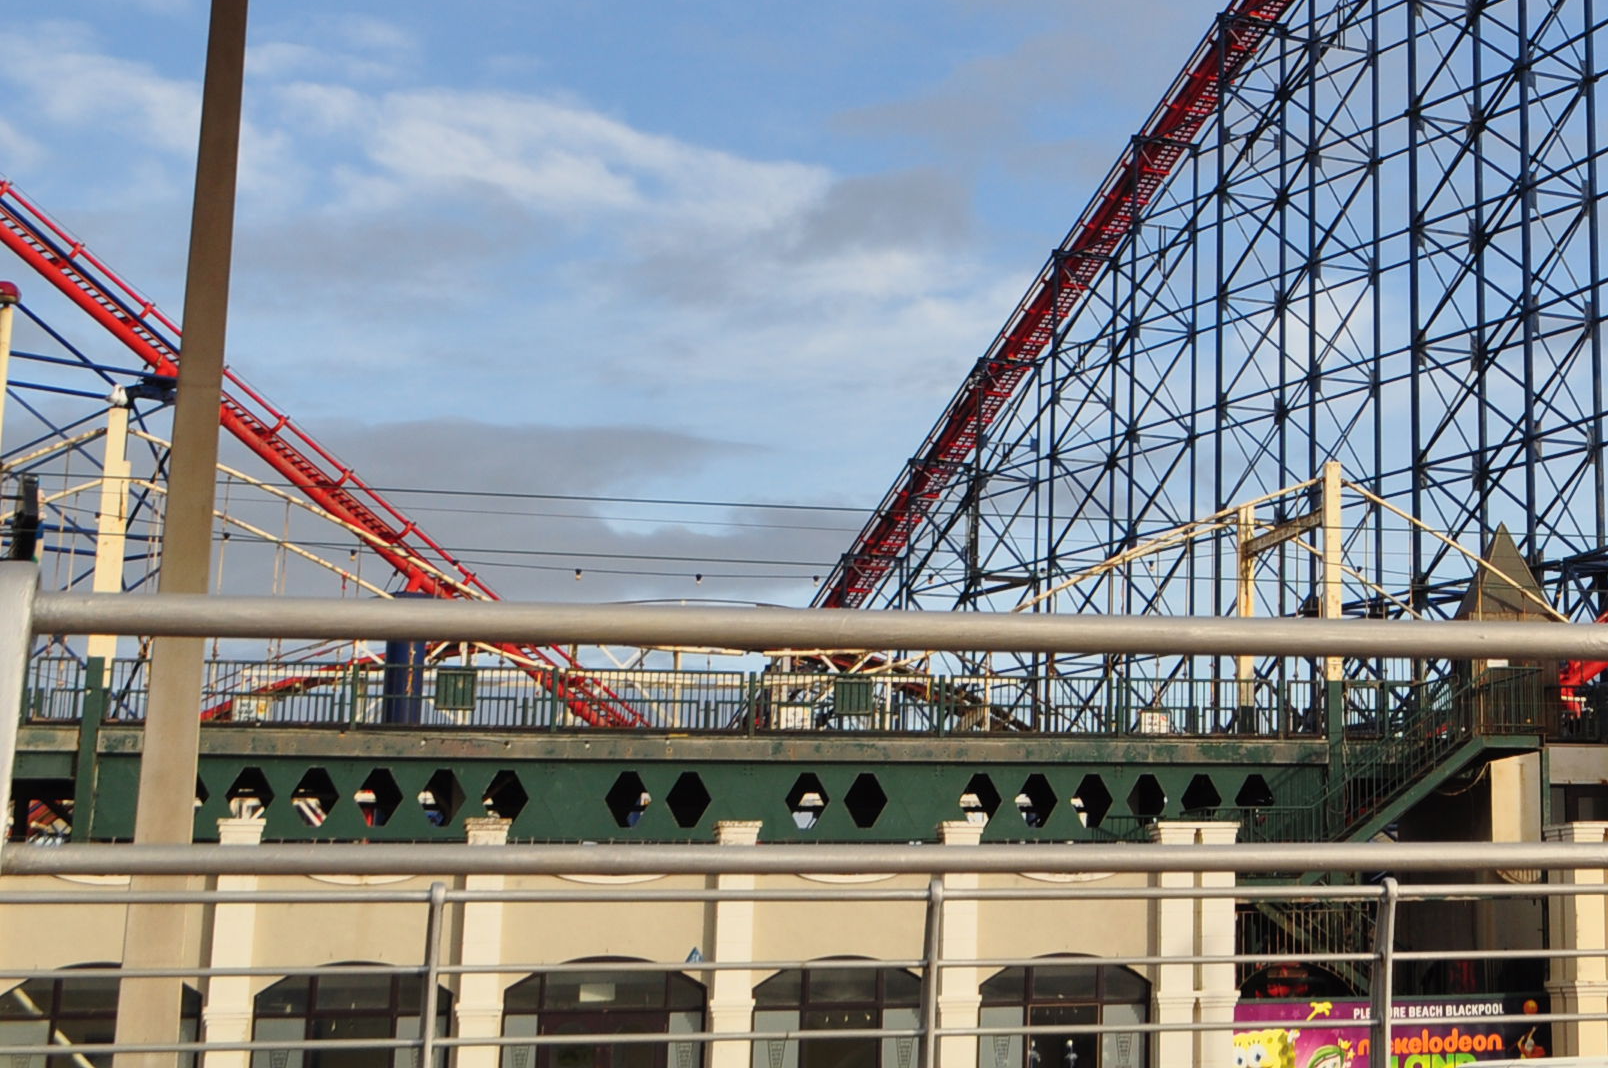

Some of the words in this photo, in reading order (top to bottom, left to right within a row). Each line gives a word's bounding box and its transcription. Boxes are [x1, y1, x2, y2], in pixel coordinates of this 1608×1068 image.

[1353, 1006, 1406, 1020] PLERE
[1408, 1005, 1443, 1018] BEACH
[1445, 1002, 1505, 1016] BLACKPOOL
[1357, 1028, 1504, 1056] nkelodeon
